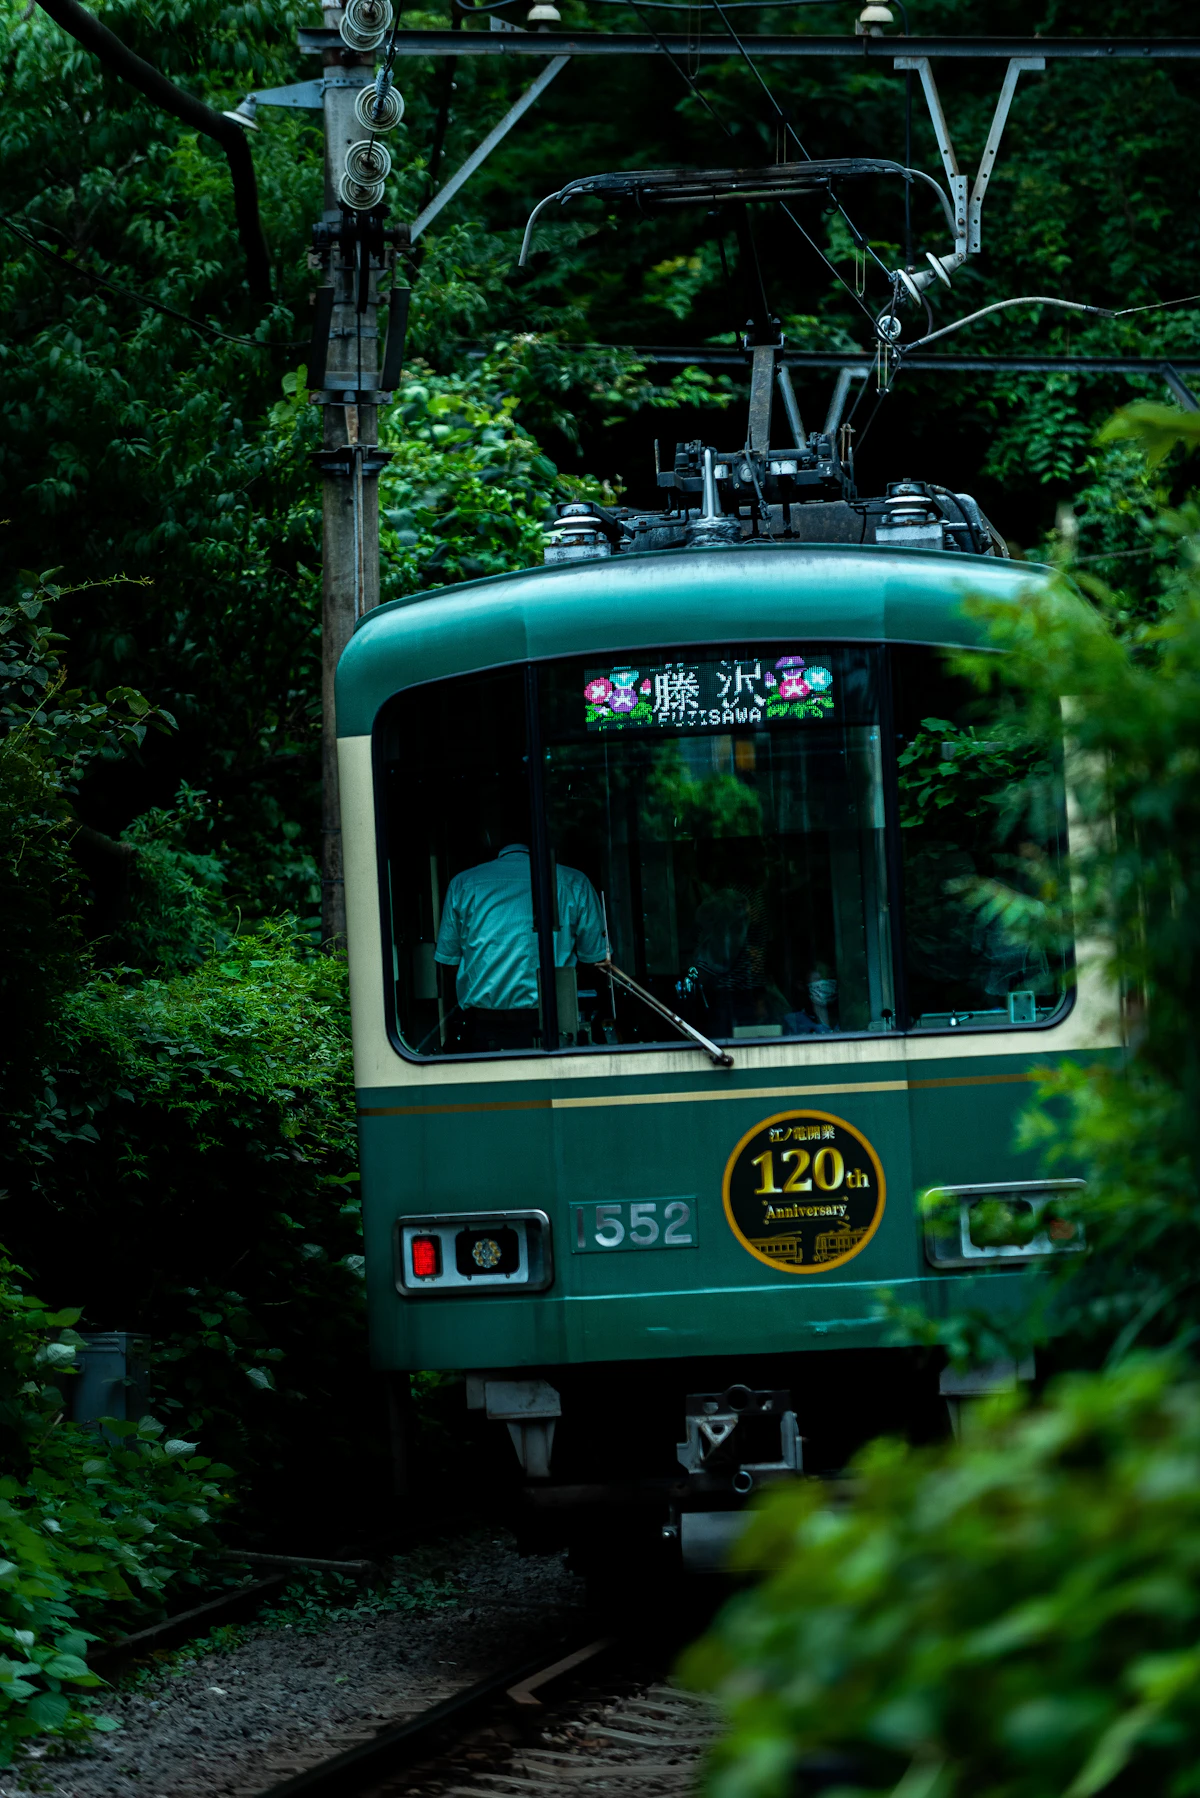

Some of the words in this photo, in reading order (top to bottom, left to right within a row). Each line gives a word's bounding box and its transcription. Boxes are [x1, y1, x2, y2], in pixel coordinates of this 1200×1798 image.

[768, 1124, 836, 1142] 江ノ電開業
[751, 1146, 870, 1194] 120th
[576, 1201, 693, 1249] 1552
[766, 1204, 847, 1220] Anniversary
